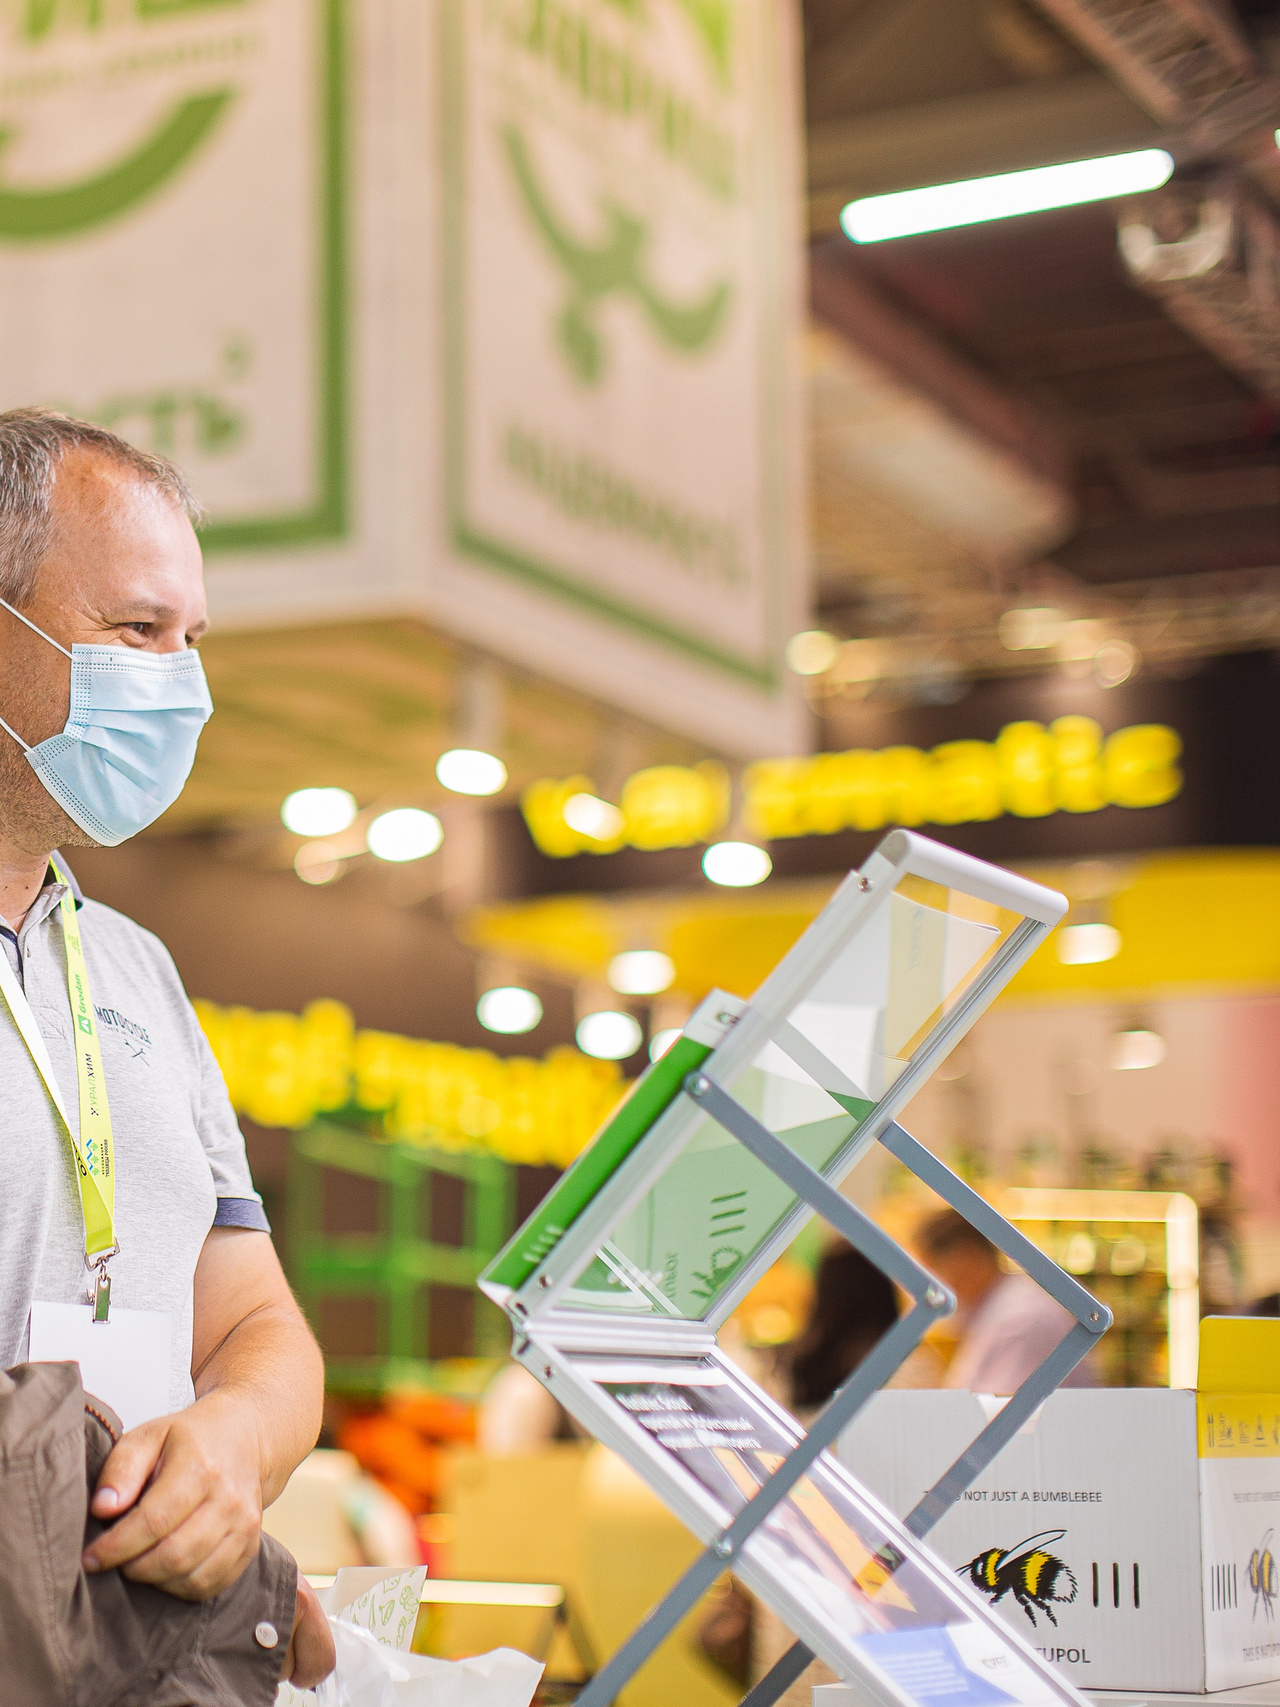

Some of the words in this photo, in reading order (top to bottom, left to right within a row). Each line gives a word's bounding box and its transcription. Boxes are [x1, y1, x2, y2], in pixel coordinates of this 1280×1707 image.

[75, 974, 86, 1013] Grodan
[85, 1053, 98, 1106] УРАЛХИМ
[964, 1491, 989, 1502] NOT
[990, 1491, 1019, 1502] JUST
[1021, 1491, 1030, 1502] A
[1033, 1491, 1103, 1503] BUMBLEBEE
